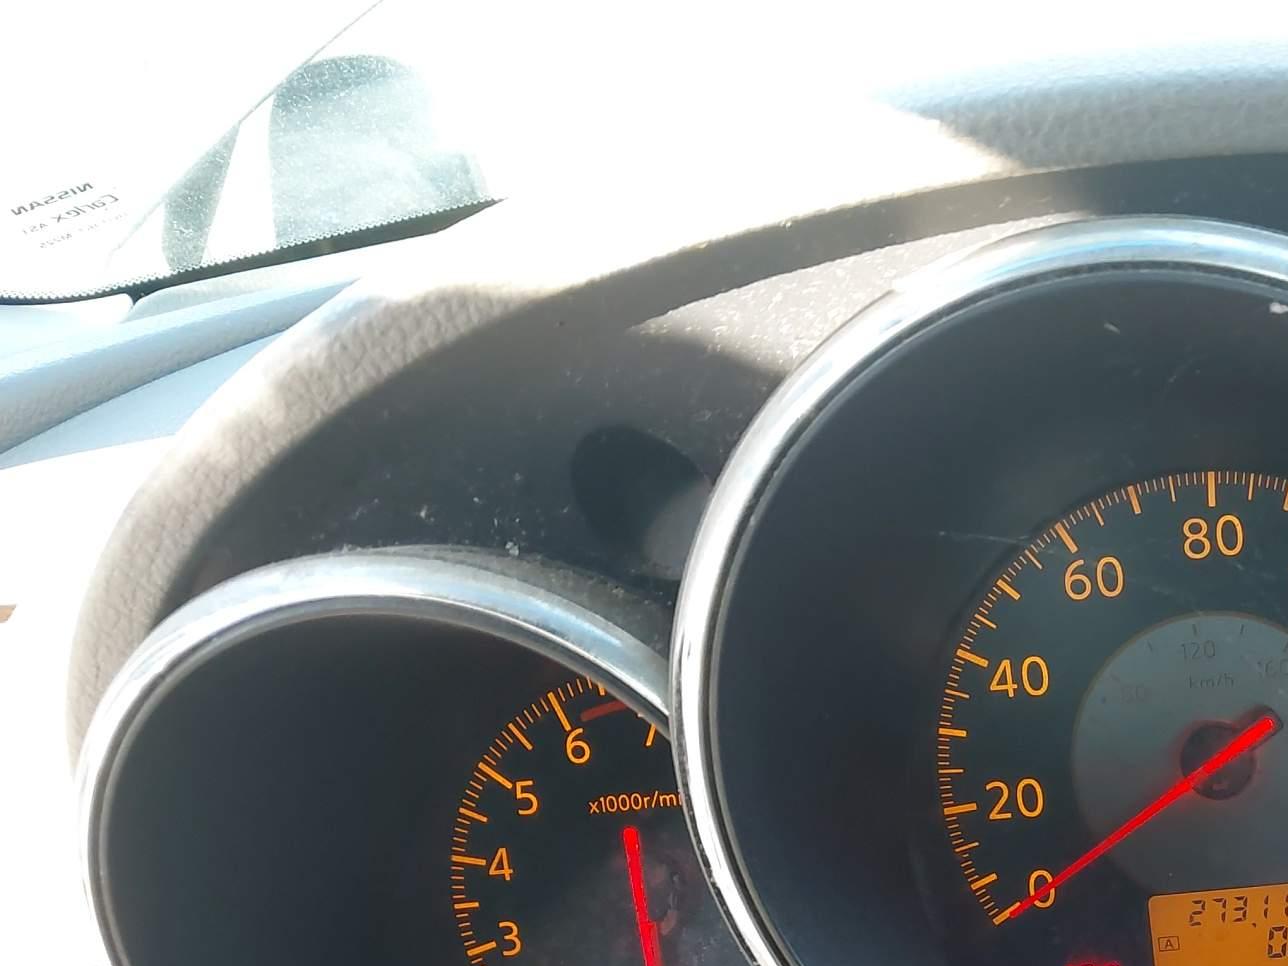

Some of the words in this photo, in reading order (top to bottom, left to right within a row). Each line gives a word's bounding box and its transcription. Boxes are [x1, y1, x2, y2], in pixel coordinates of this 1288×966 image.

[1182, 514, 1245, 560] 80
[1063, 556, 1124, 601] 60
[1180, 639, 1217, 662] 120
[988, 655, 1050, 698] 40
[564, 727, 591, 764] 6
[515, 780, 538, 815] 5
[985, 778, 1044, 820] 20
[488, 847, 513, 881] 4
[1028, 869, 1056, 908] 0
[498, 921, 522, 956] 3
